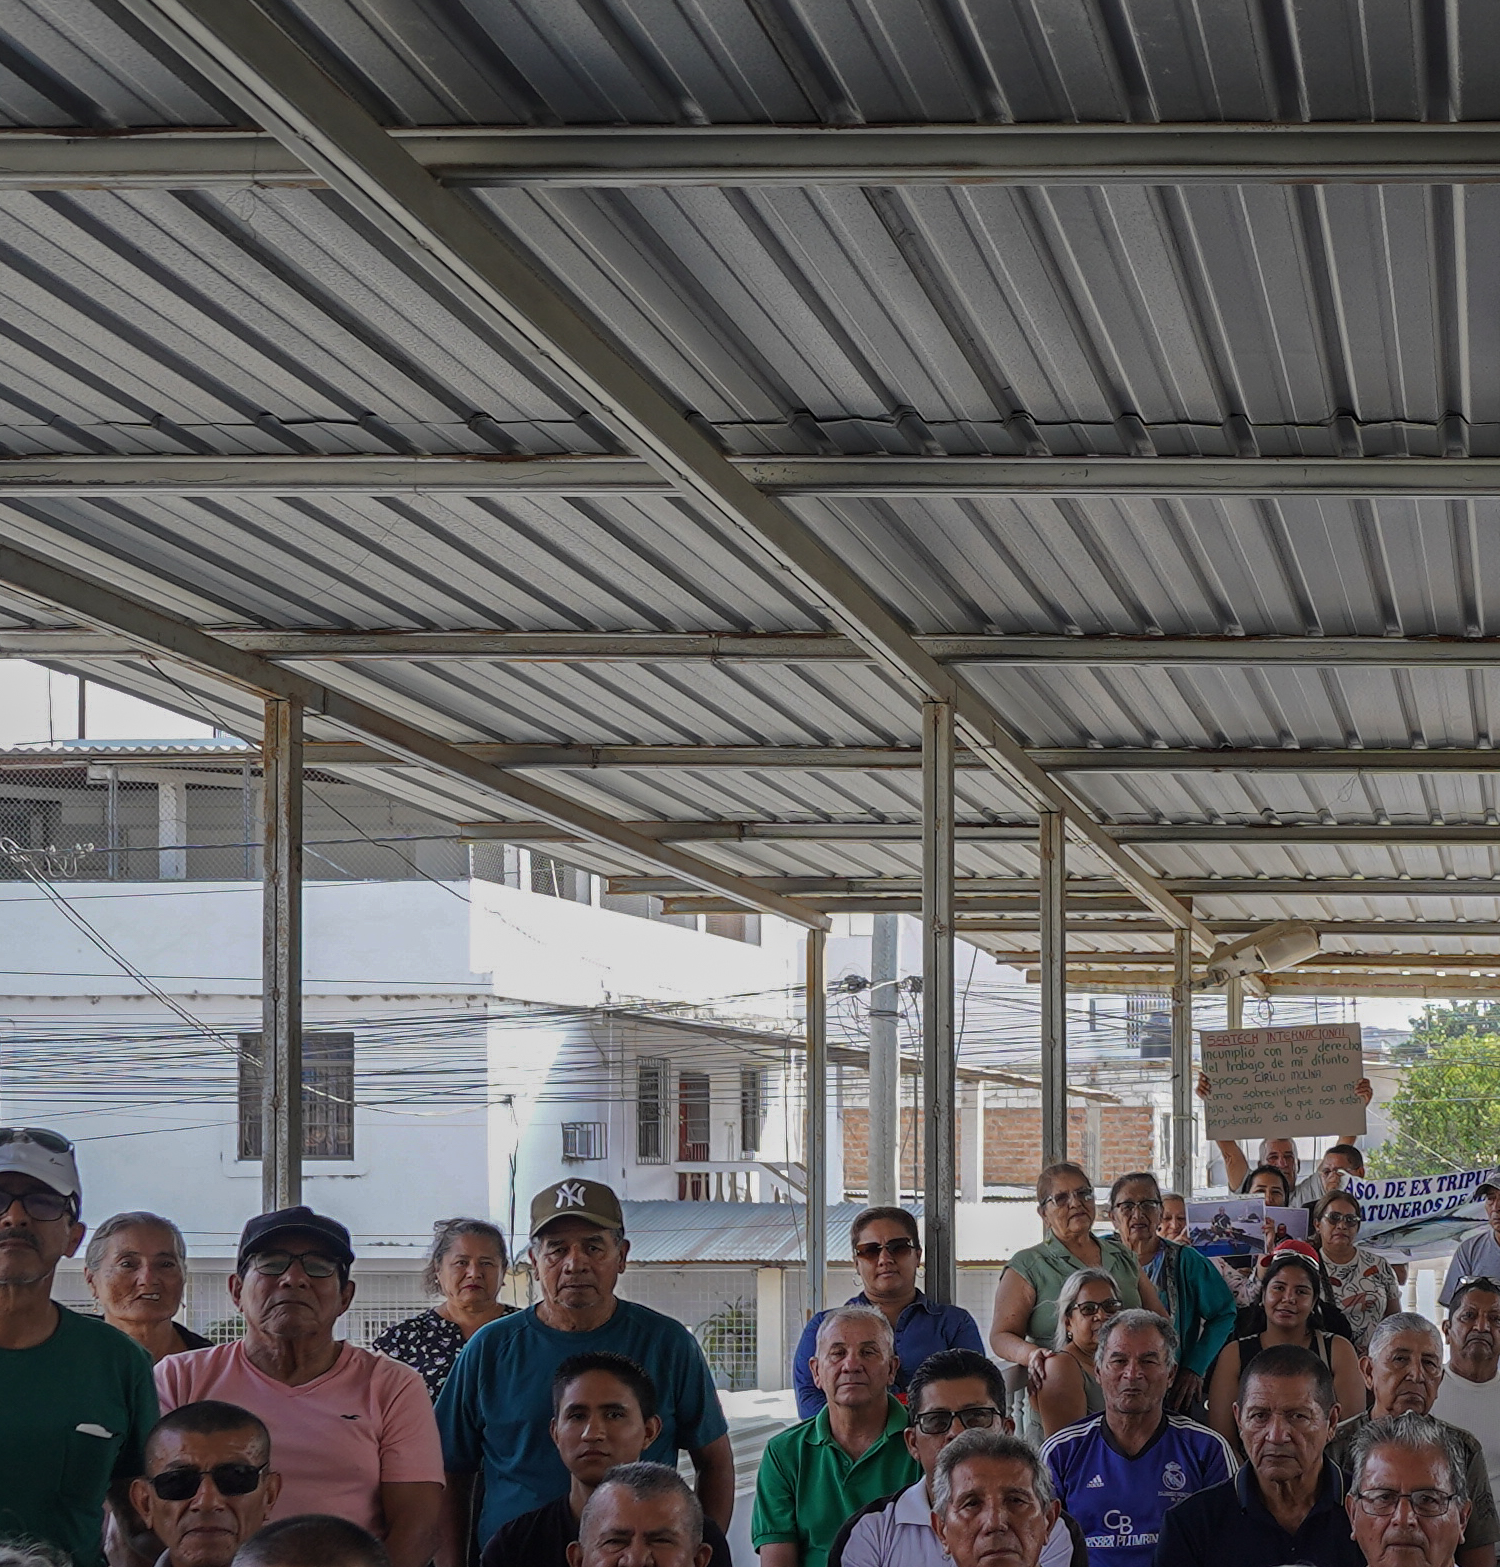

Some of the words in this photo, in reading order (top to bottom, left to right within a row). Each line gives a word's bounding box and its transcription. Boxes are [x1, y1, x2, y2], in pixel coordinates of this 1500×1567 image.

[1267, 1028, 1348, 1043] INTERNACIONAL
[1264, 1047, 1281, 1056] con
[1291, 1041, 1308, 1054] los
[1227, 1060, 1264, 1073] trabajo
[1271, 1058, 1284, 1068] de
[1292, 1059, 1303, 1068] mi
[1312, 1055, 1349, 1066] difunto
[1322, 1083, 1336, 1093] con
[1385, 1182, 1406, 1199] DE
[1409, 1179, 1432, 1197] EX
[1359, 1198, 1441, 1222] ATUNEROS
[1444, 1194, 1468, 1210] DE
